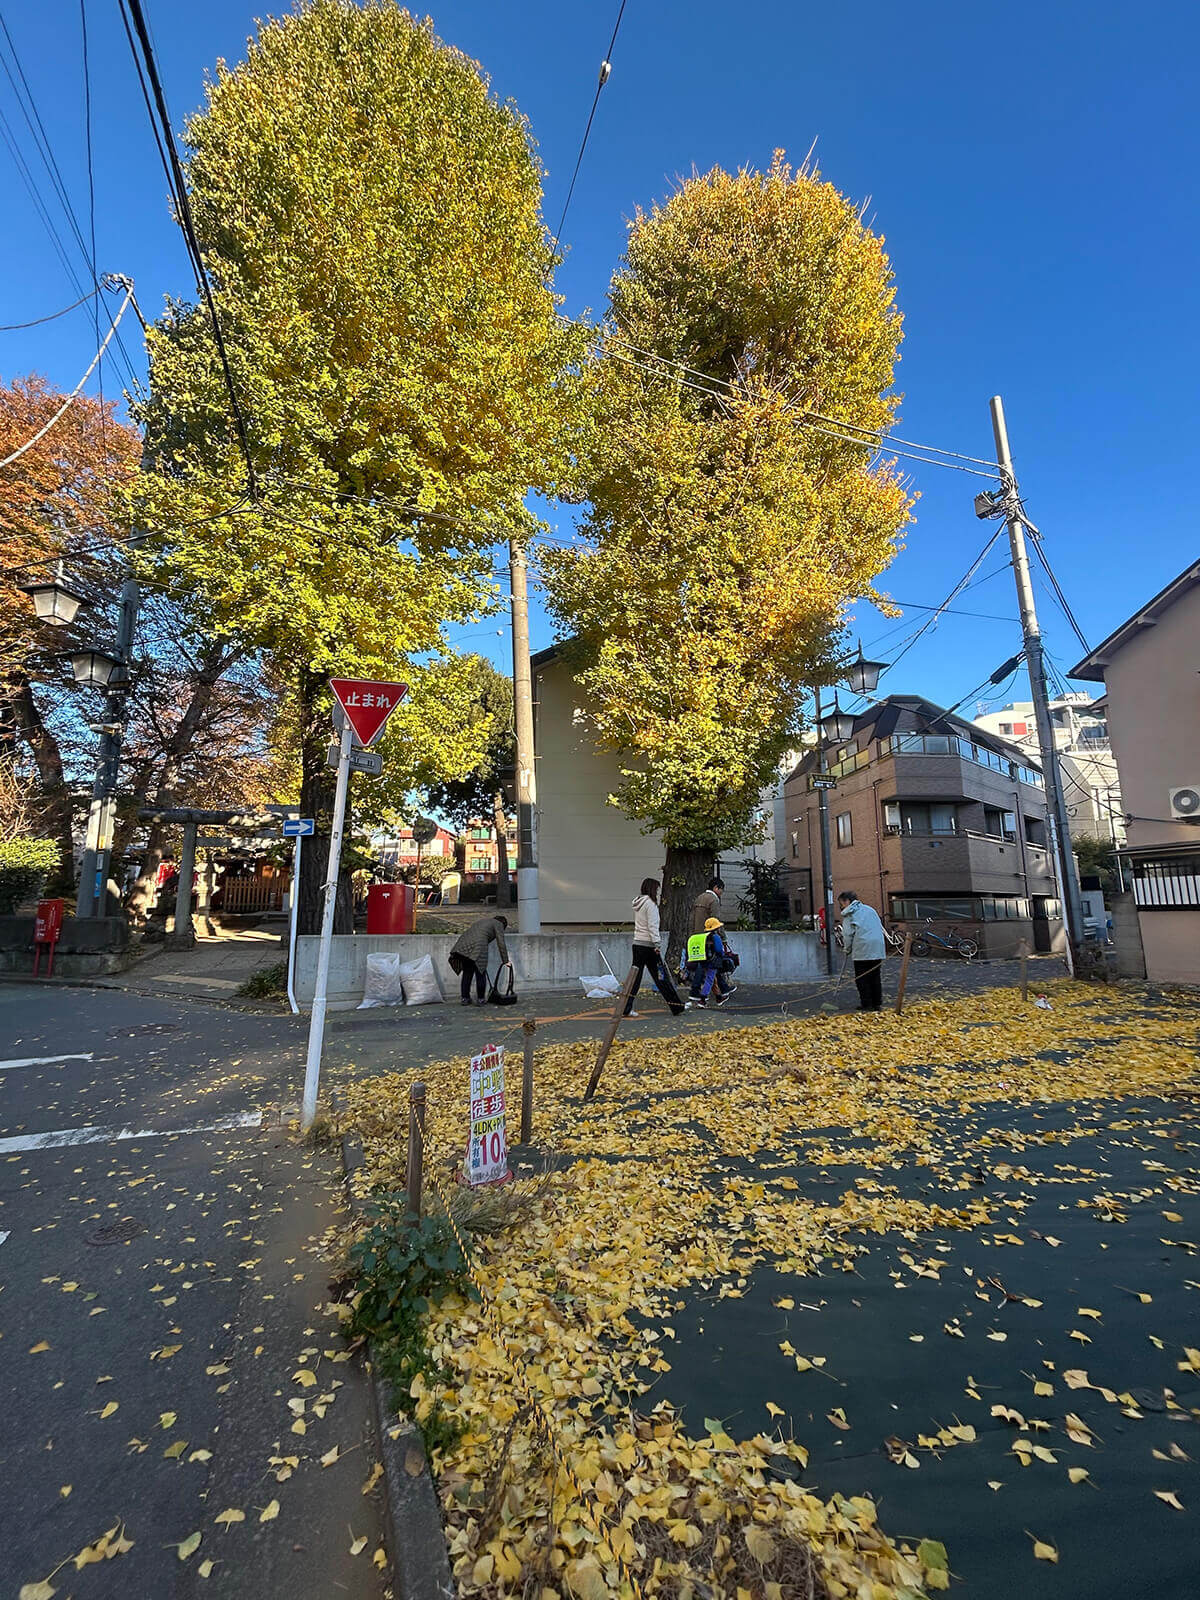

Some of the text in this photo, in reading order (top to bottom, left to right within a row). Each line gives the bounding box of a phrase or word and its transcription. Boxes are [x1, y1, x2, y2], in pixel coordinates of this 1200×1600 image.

[345, 691, 391, 708] 止まれ
[474, 1096, 503, 1118] 徒歩
